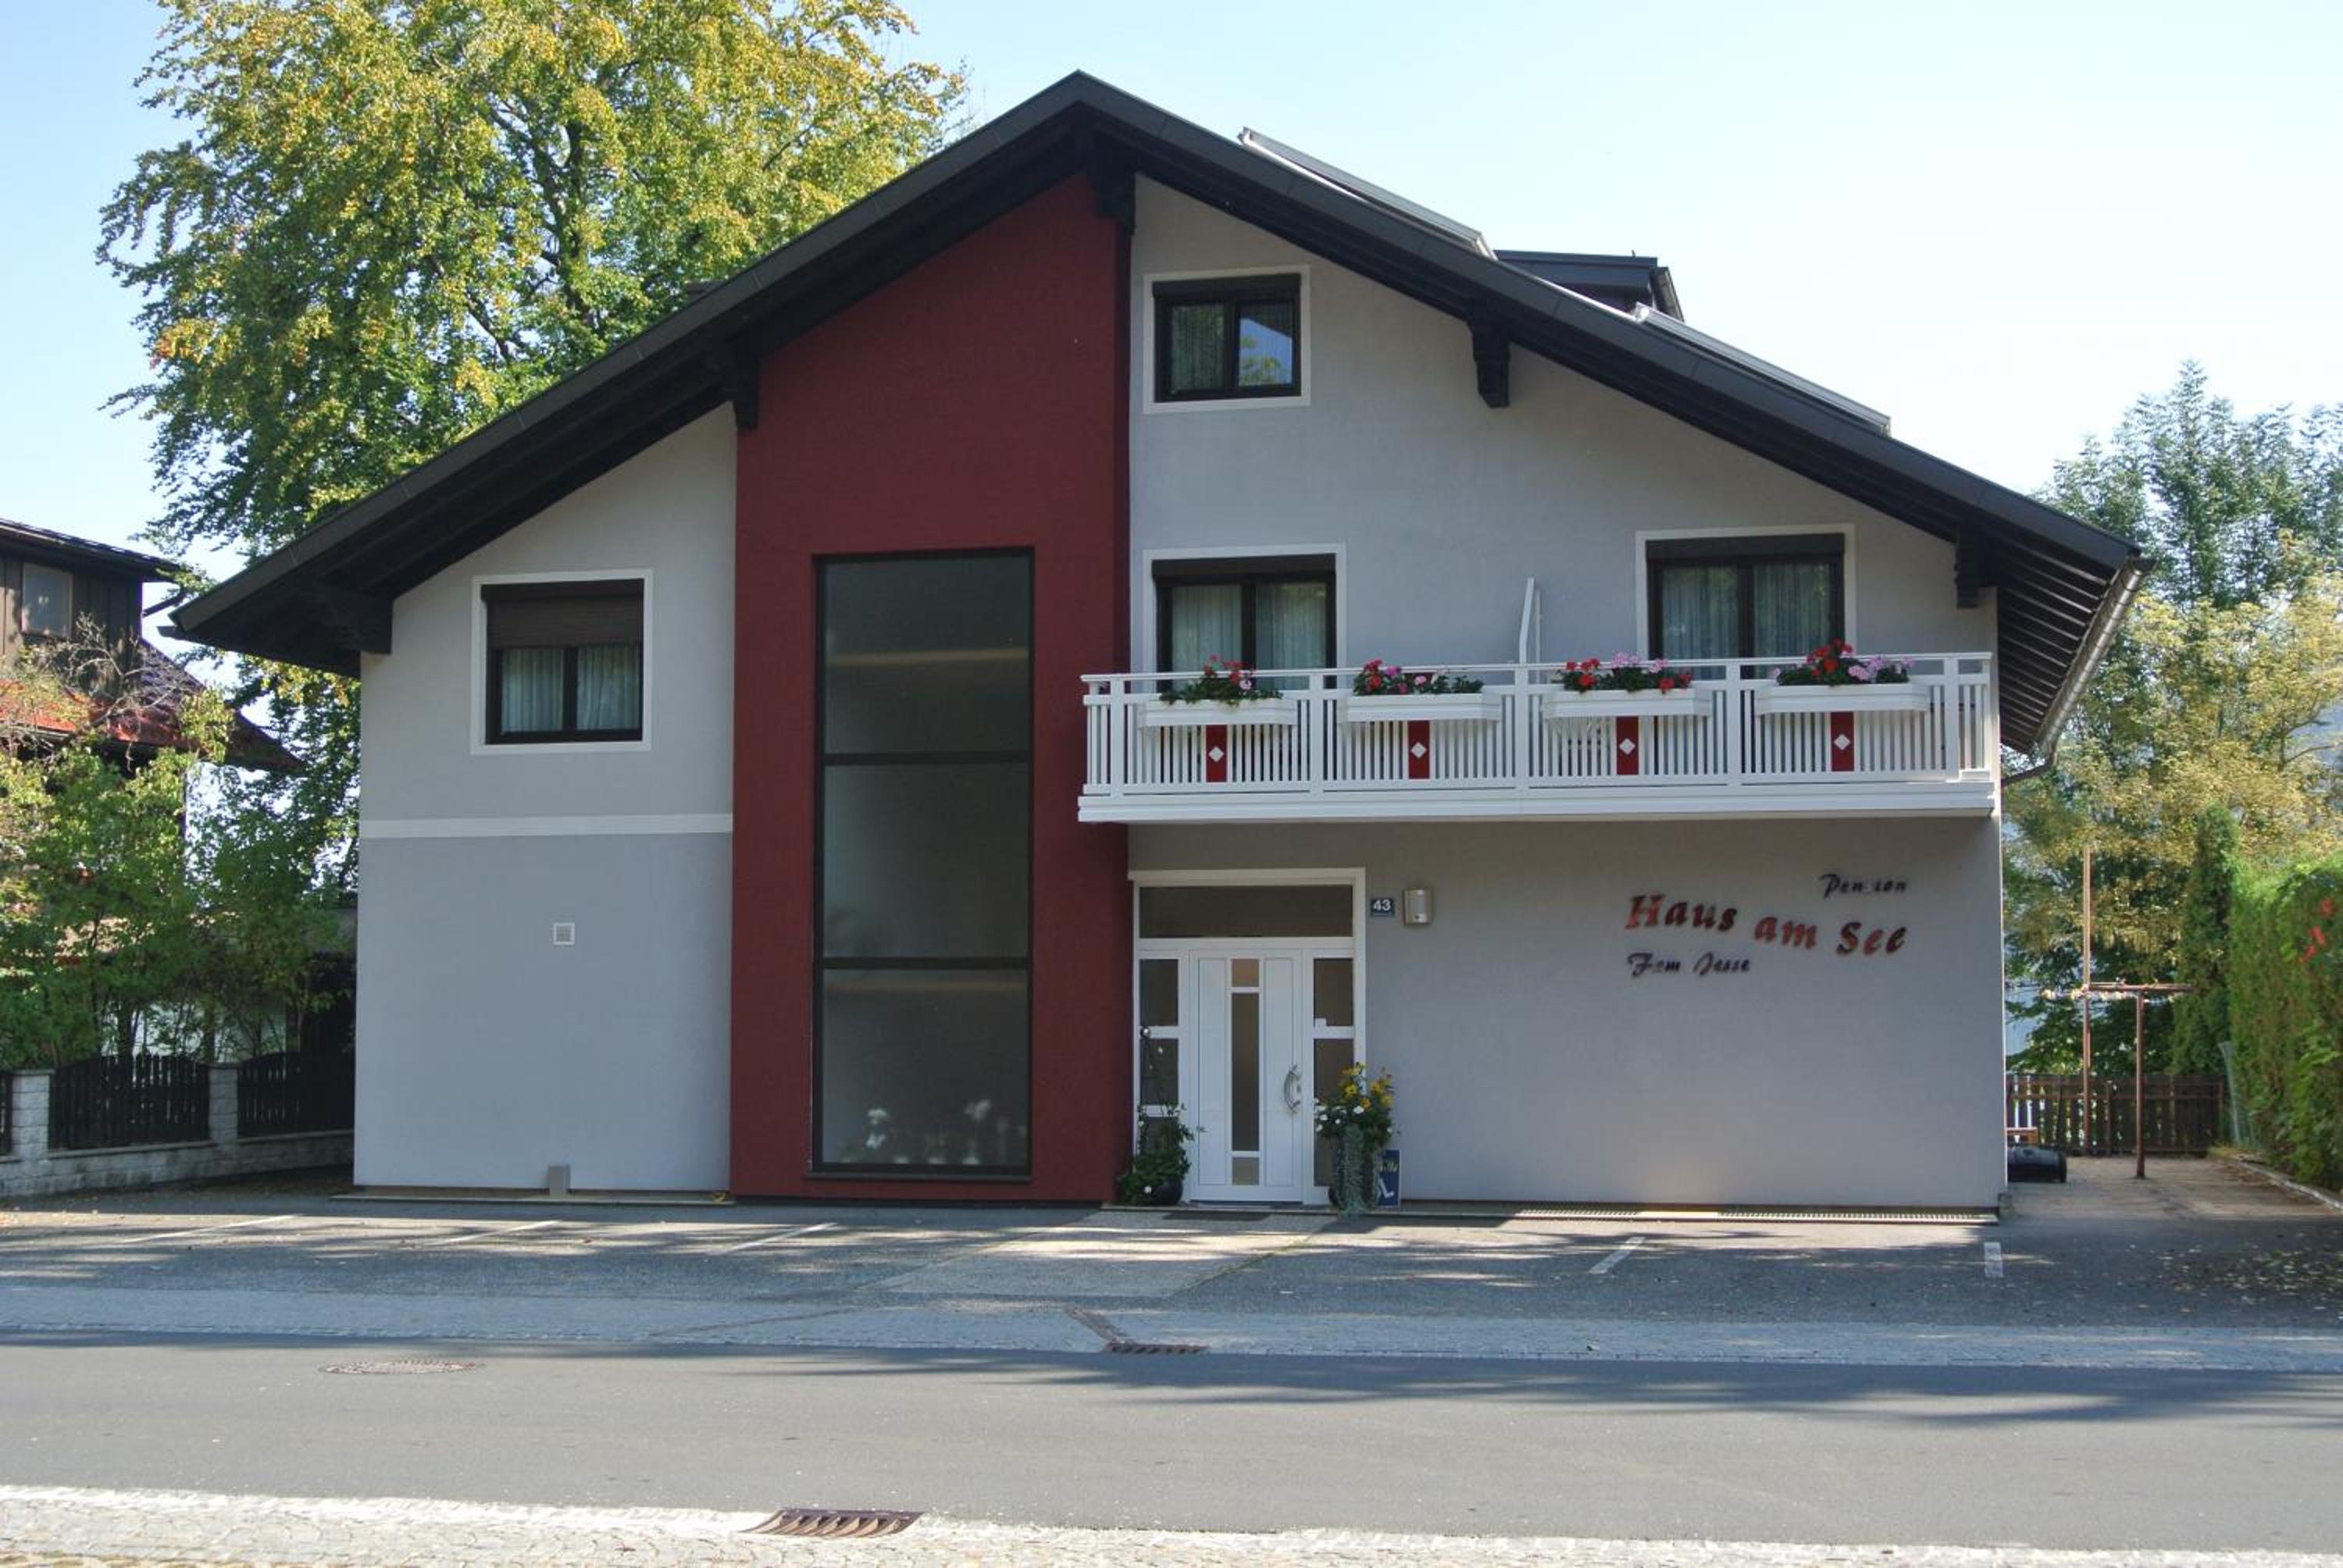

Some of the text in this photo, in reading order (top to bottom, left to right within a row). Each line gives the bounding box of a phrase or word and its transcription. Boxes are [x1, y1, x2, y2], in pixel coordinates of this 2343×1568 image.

[1817, 873, 1908, 900] Penion
[1373, 899, 1391, 911] 43
[1624, 893, 1908, 955] Haus am See
